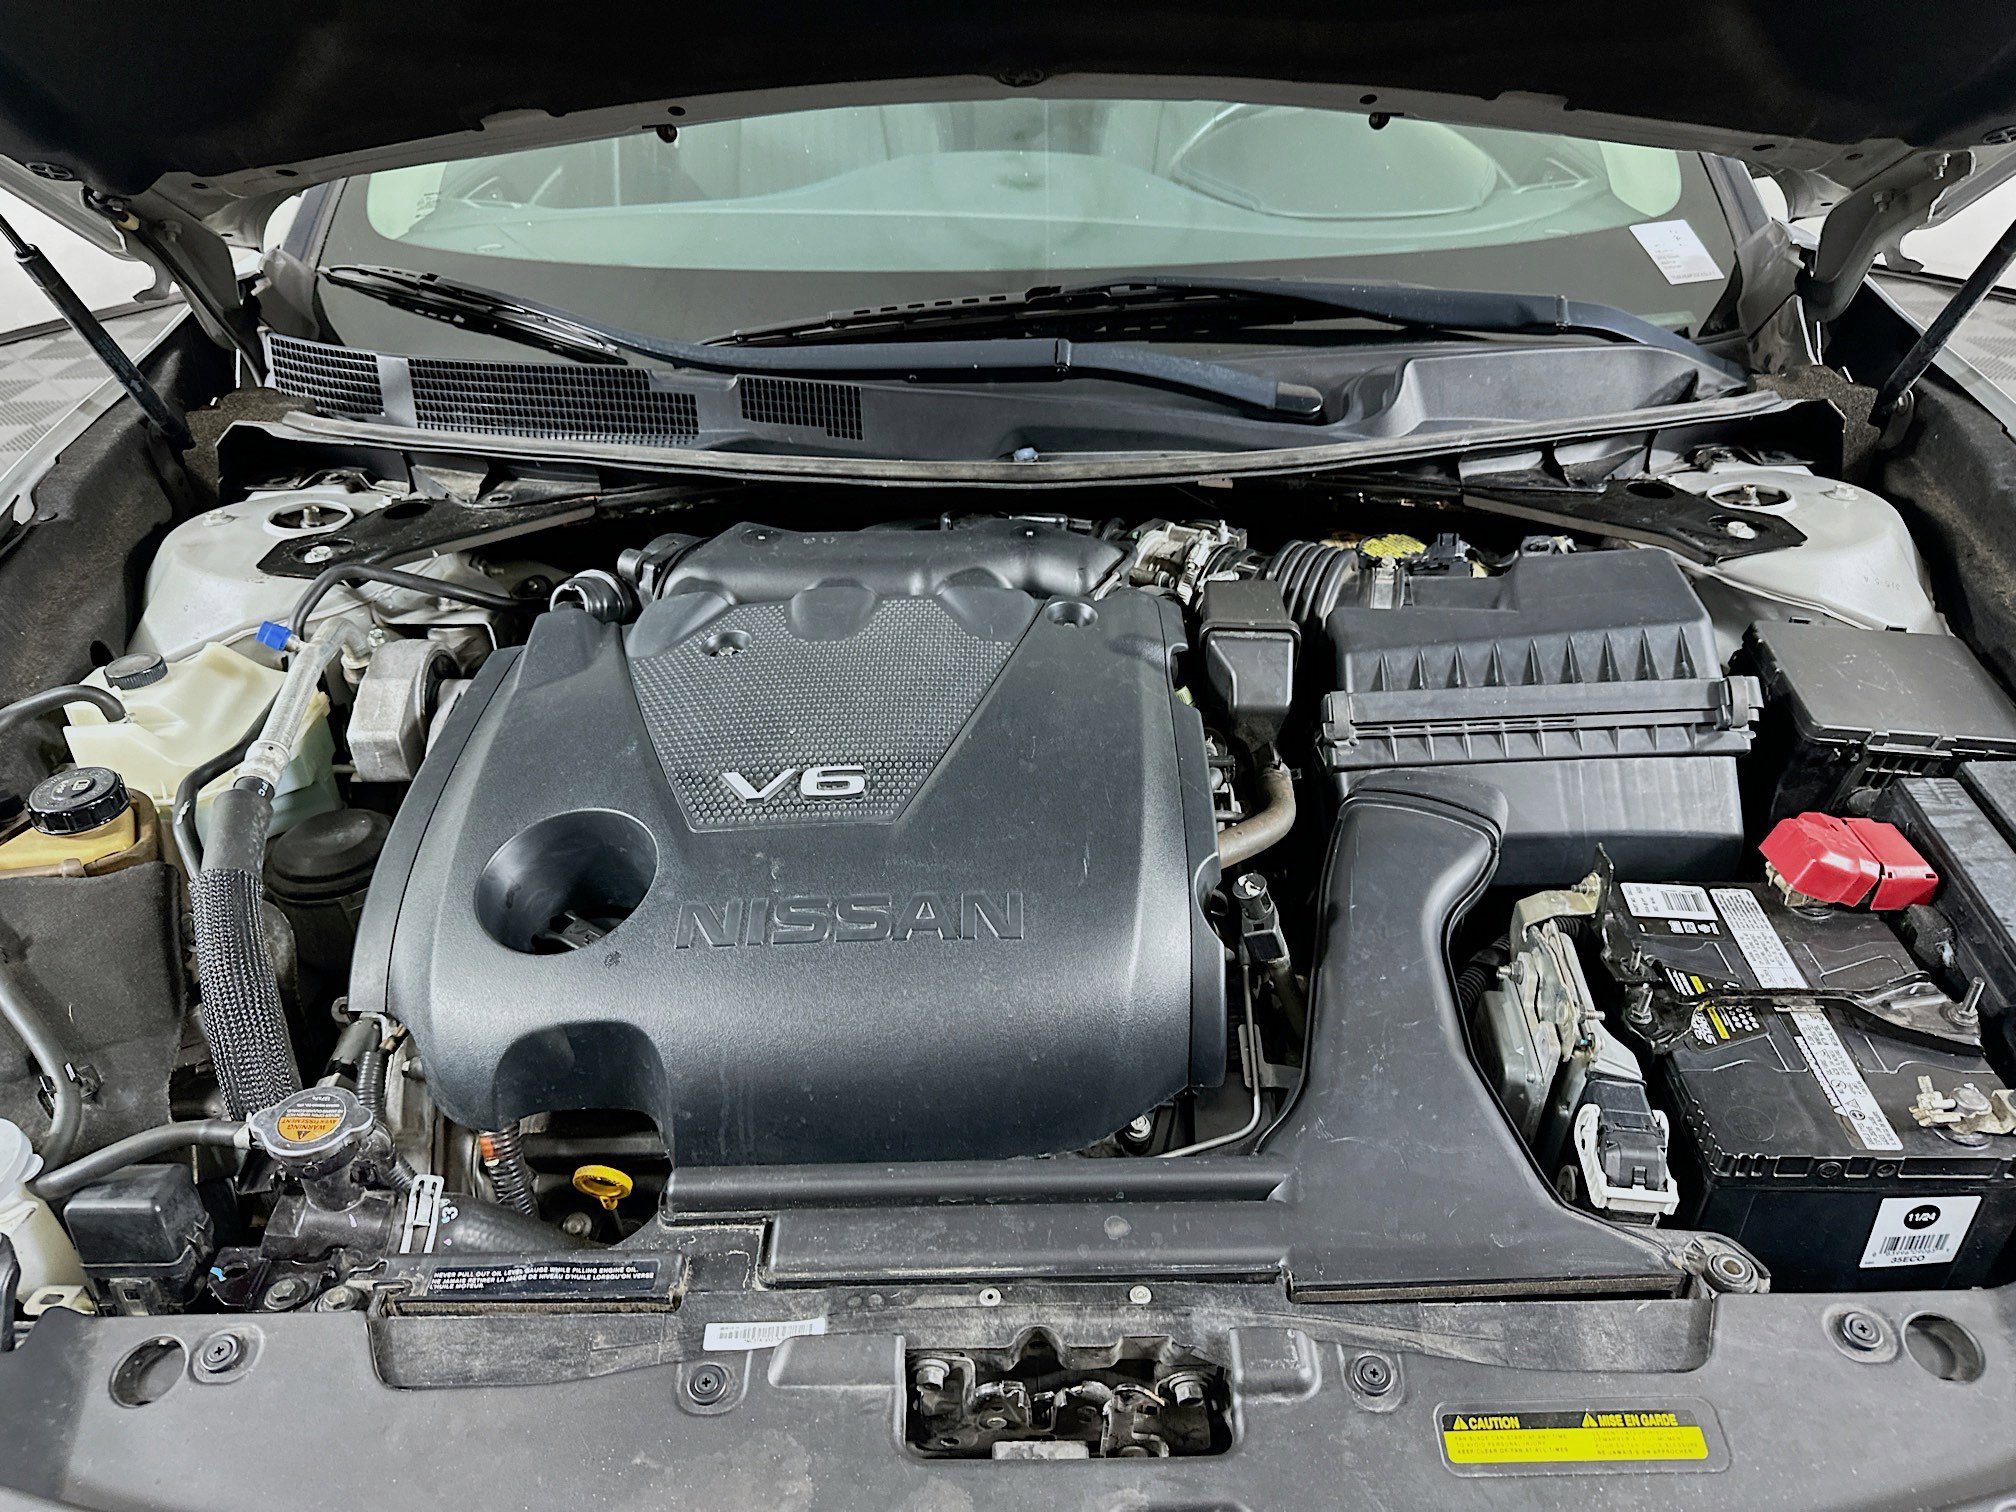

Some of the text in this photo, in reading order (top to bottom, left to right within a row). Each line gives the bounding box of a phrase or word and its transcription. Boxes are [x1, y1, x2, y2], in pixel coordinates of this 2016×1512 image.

[719, 765, 868, 804] V6
[675, 892, 1024, 949] NISSAN
[1908, 1212, 1937, 1222] 11/24
[1468, 1416, 1520, 1430] CAUTION
[1597, 1413, 1677, 1427] MISE EN GARDE
